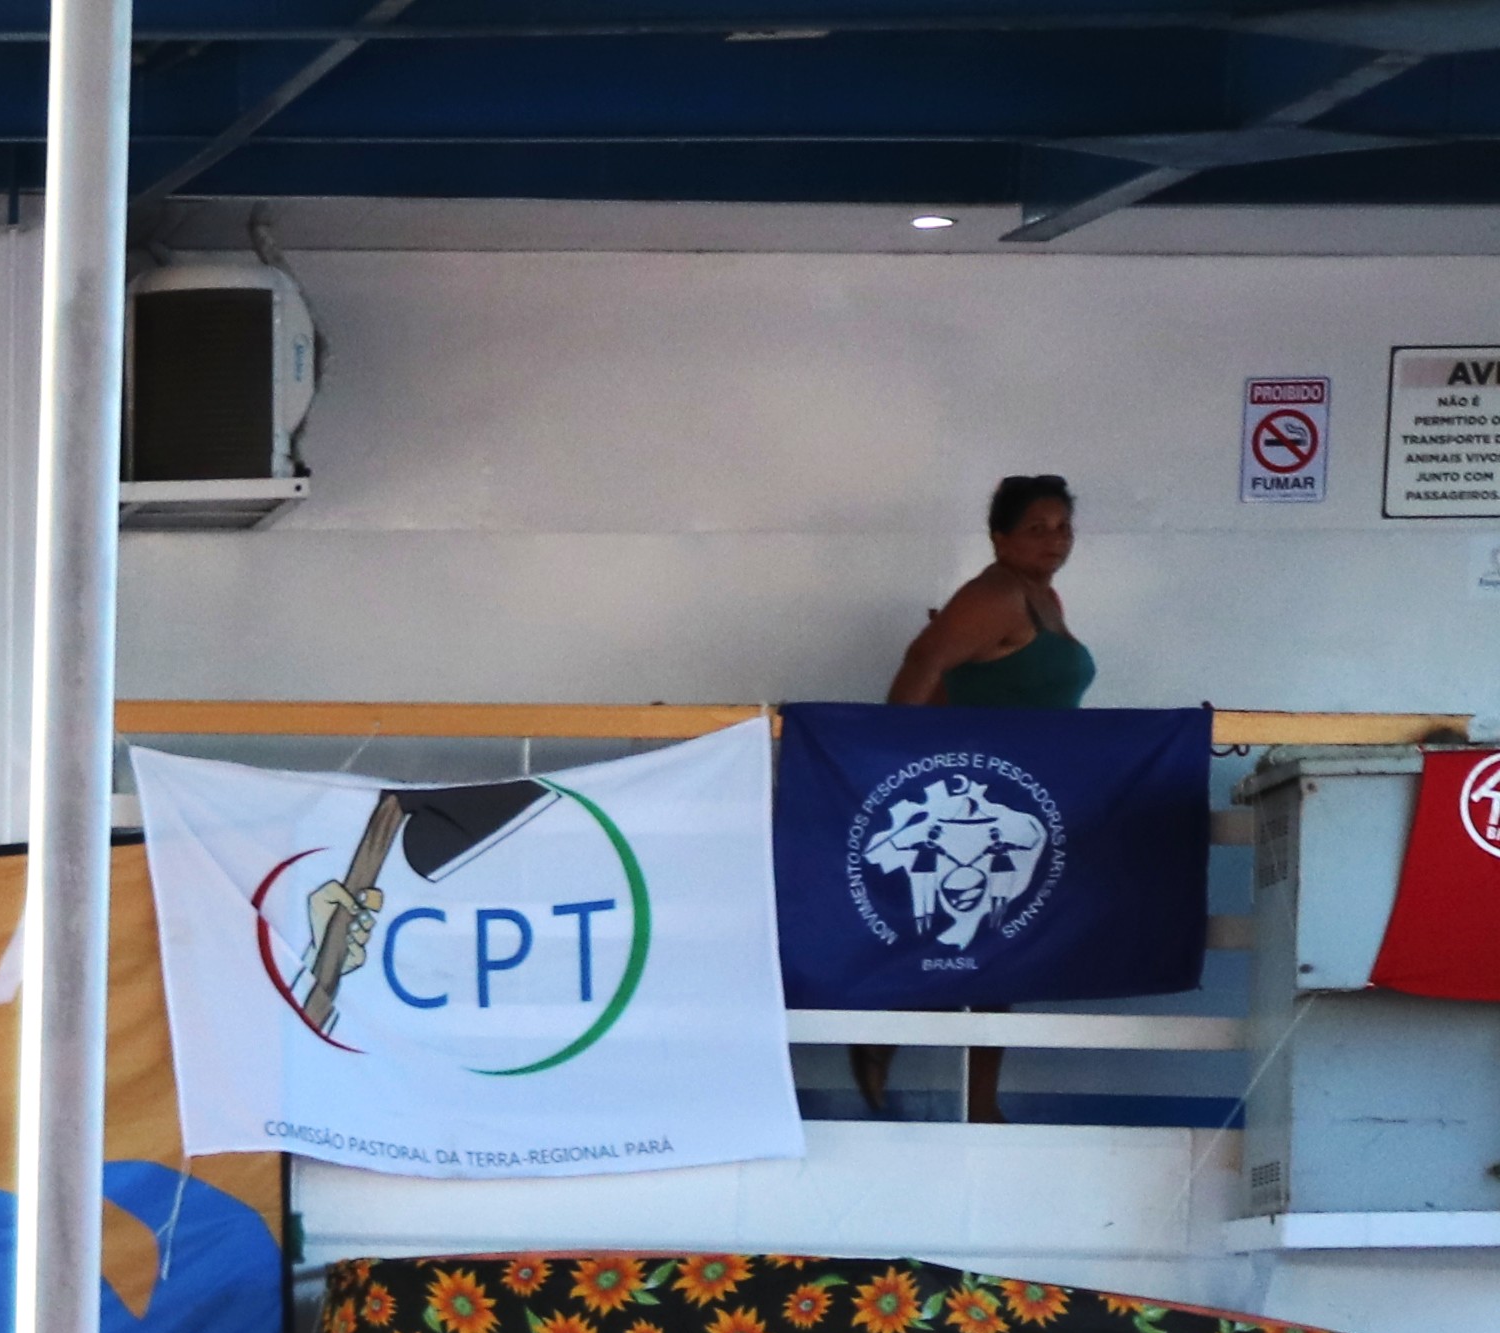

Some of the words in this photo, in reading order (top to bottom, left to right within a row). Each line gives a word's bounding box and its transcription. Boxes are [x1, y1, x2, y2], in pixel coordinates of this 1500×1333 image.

[1254, 385, 1321, 401] PROIBIDO
[1438, 394, 1468, 407] NÃO
[1472, 394, 1481, 407] É
[1414, 416, 1488, 426] PERMITIDO
[1402, 434, 1491, 445] TRANSPORTE
[1405, 453, 1462, 463] ANIMAIS
[1465, 453, 1500, 463] VIVO
[1251, 476, 1315, 491] FUMAR
[1416, 472, 1460, 482] JUNTO
[1463, 472, 1494, 482] COM
[1406, 491, 1500, 500] PASSAGEIROS.
[972, 753, 985, 769] E
[861, 752, 970, 815] PESCADORES
[986, 755, 1067, 846] PESCADORAS
[848, 813, 870, 850] DOS
[847, 852, 899, 946] MOVIMENTO
[1001, 848, 1066, 939] ARTESANAIS
[383, 899, 616, 1009] CPT
[921, 957, 979, 971] BRASIL
[264, 1120, 345, 1151] COMISSÃO
[348, 1136, 429, 1164] PASTORAL
[436, 1148, 460, 1166] DA
[466, 1141, 620, 1169] TERRA-REGIONAL
[624, 1134, 675, 1157] PARÁ
